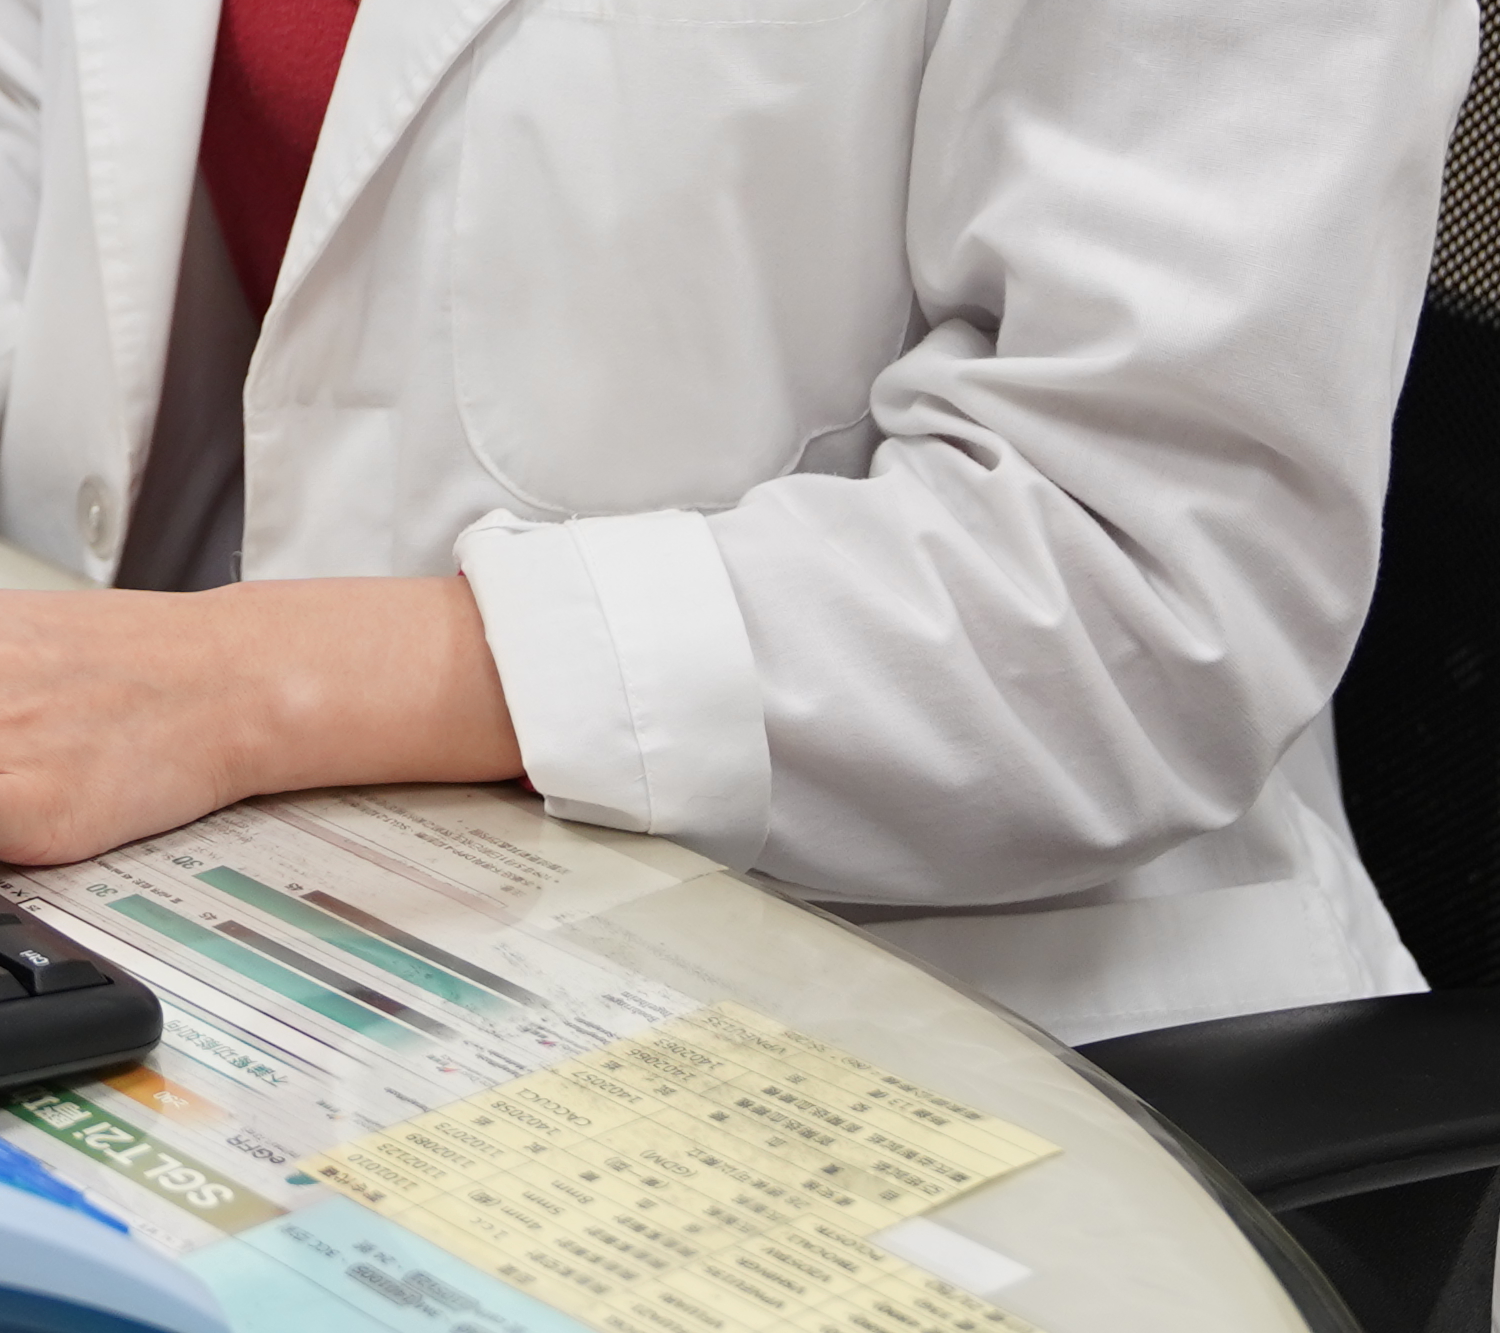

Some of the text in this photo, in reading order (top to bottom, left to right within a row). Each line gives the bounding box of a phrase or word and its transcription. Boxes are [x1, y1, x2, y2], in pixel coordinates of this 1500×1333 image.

[170, 854, 205, 871] 30
[87, 882, 119, 899] 30
[18, 948, 53, 967] Ctrl
[225, 1135, 287, 1166] eGFR
